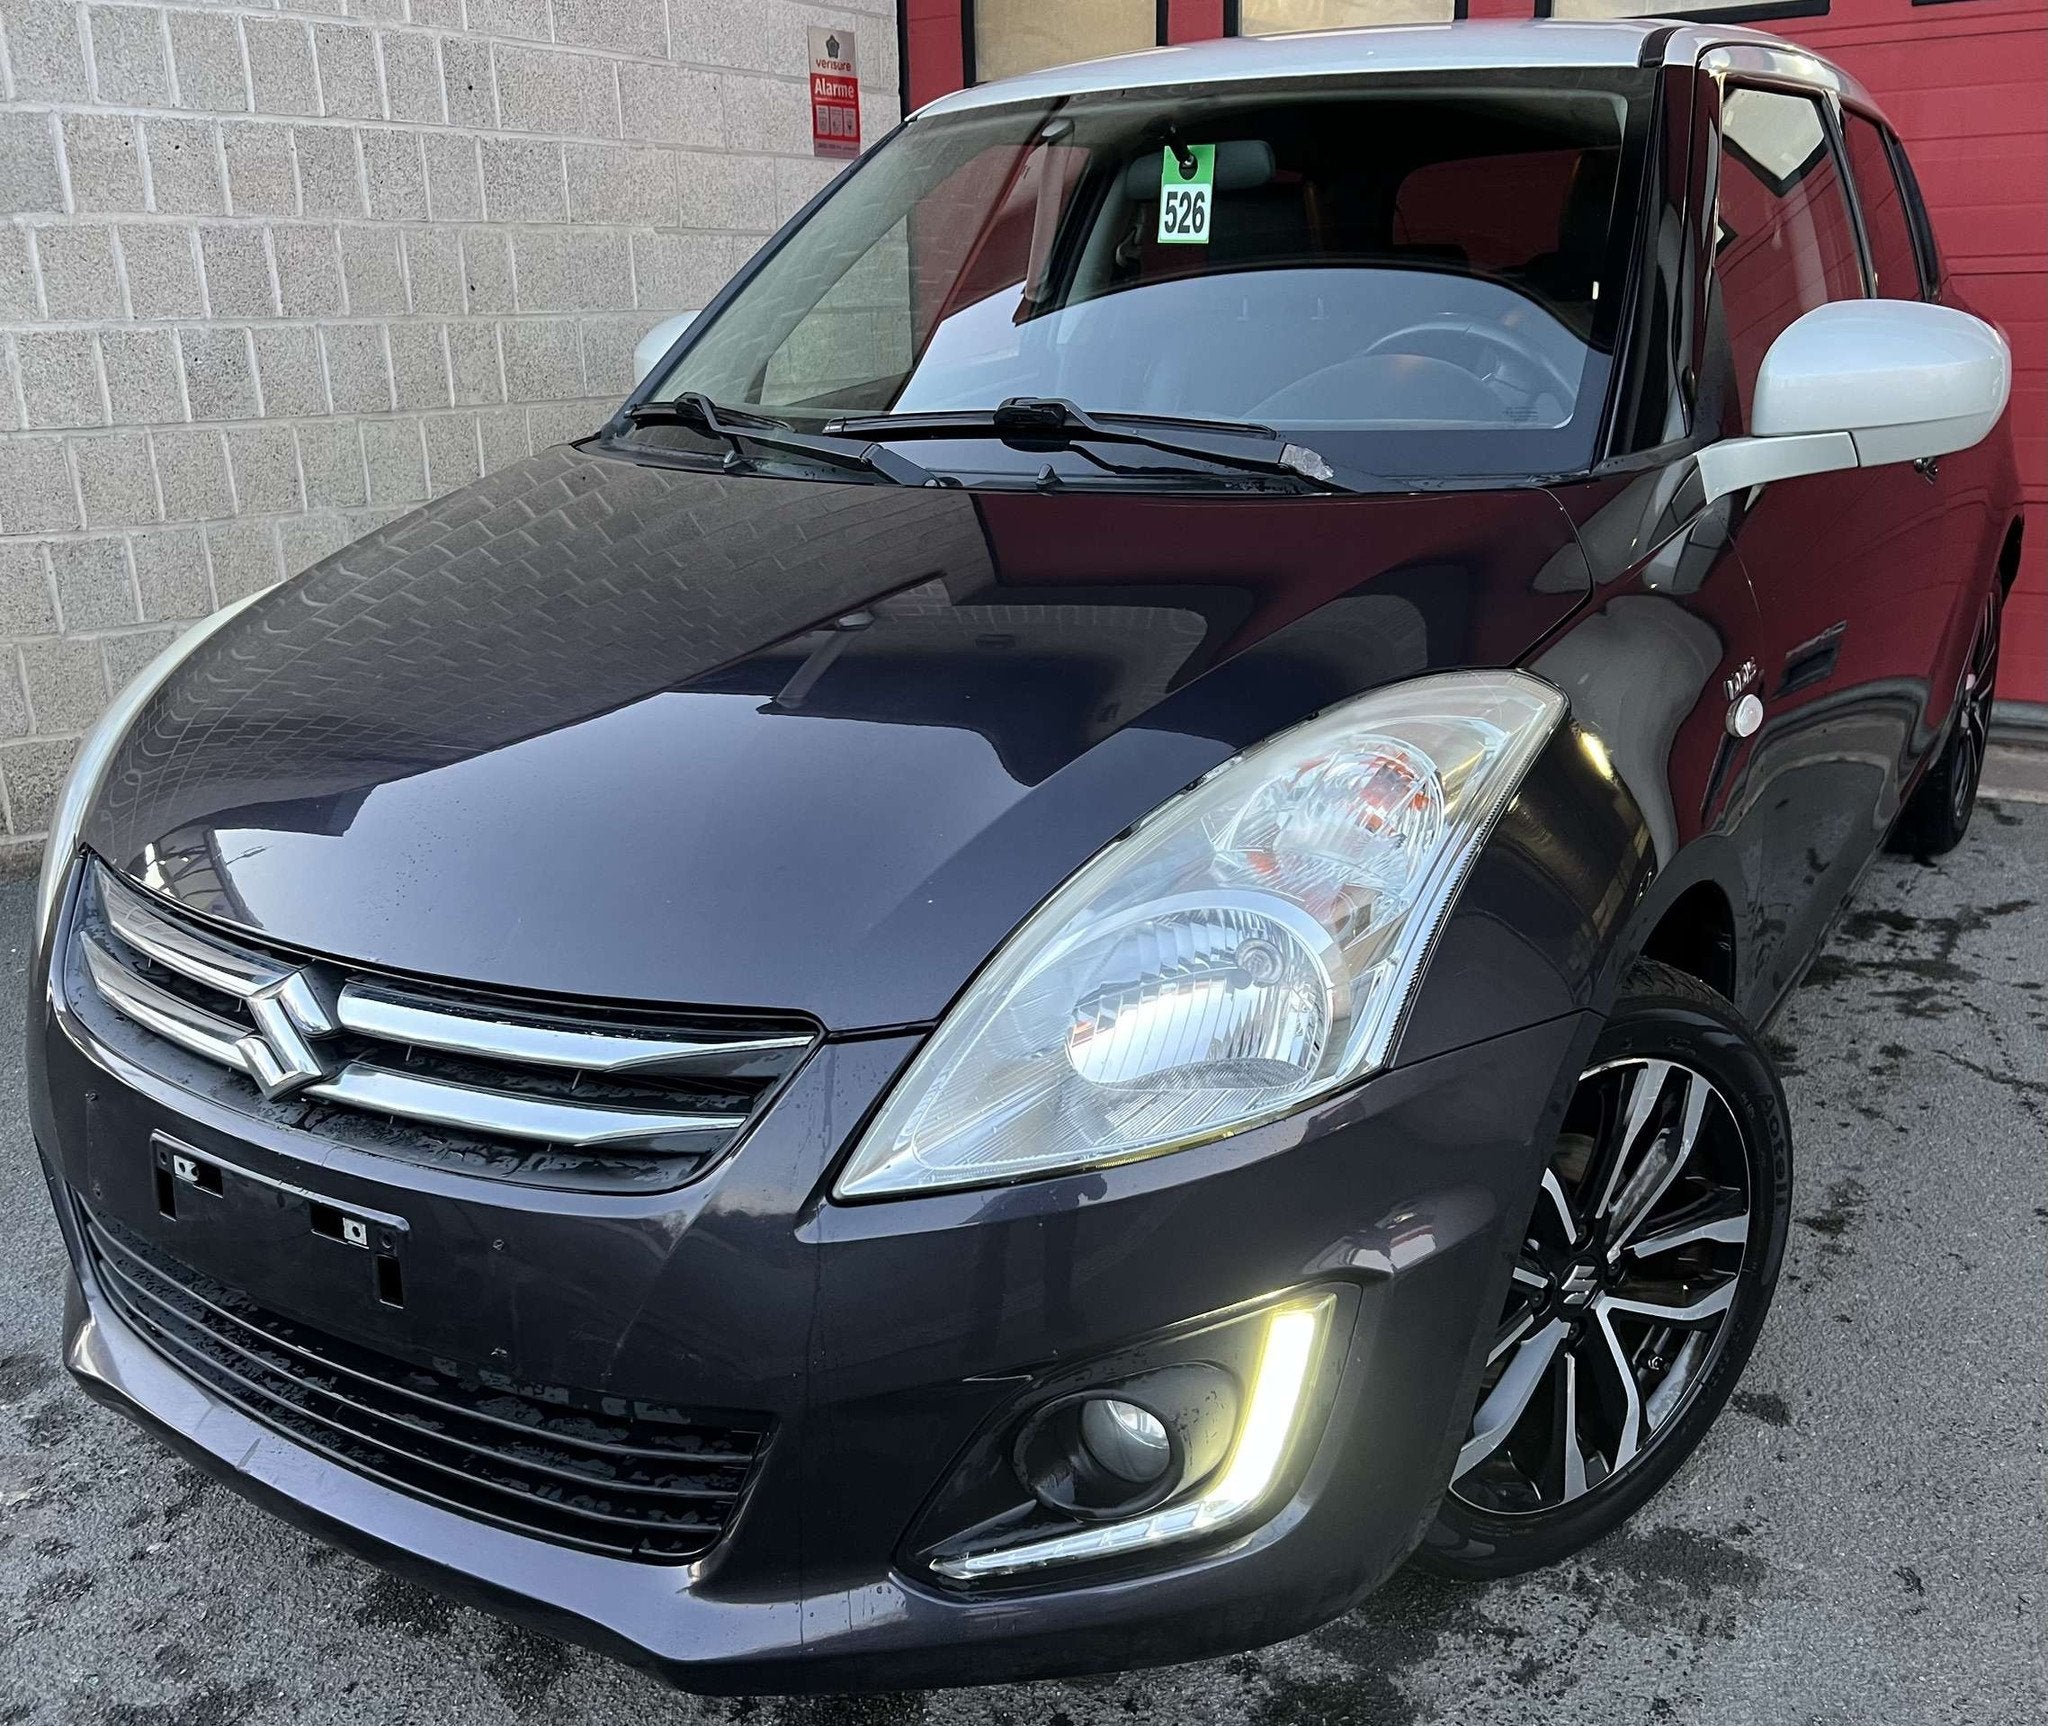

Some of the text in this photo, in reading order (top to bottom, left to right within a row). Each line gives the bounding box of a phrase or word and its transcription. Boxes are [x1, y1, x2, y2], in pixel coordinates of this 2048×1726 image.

[815, 58, 852, 71] verisure
[814, 77, 855, 98] Alarme
[1164, 191, 1206, 234] 526
